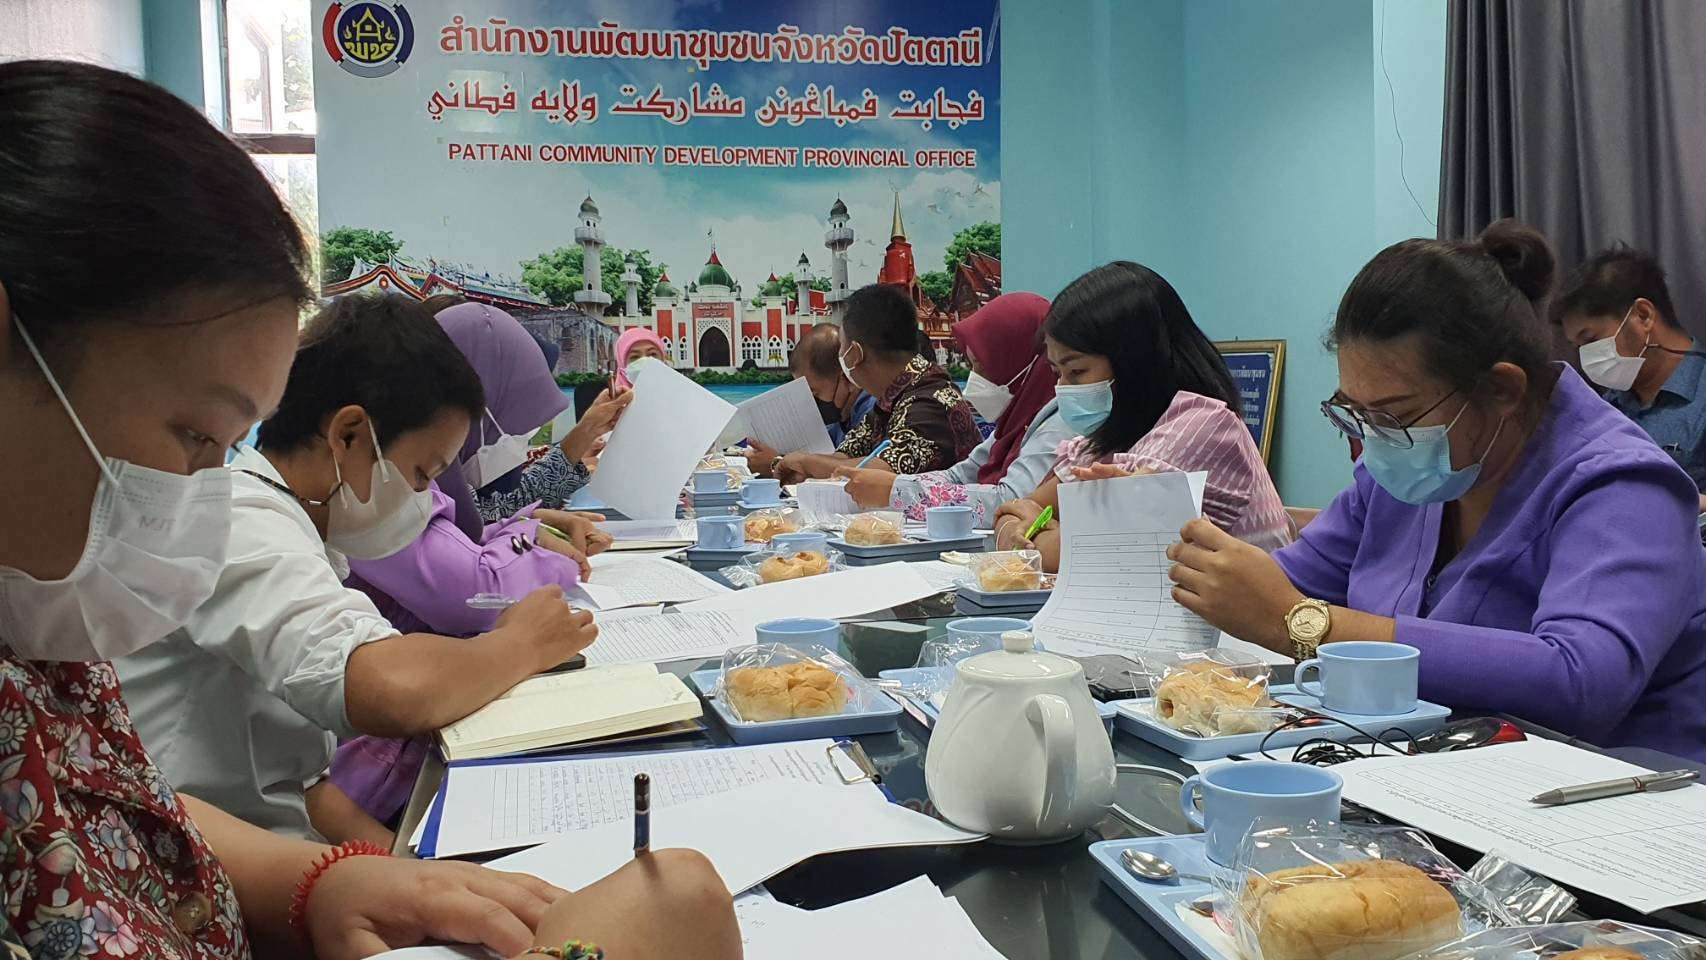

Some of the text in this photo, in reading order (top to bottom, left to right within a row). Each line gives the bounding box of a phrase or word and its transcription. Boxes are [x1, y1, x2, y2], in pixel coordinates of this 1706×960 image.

[439, 15, 981, 67] สำนักงานพัฒนาชุมชนจังหวัดปัตตานี
[449, 143, 976, 168] PATTANI COMMUNITY DEVELOPMENT PROVINCIAL OFFICE
